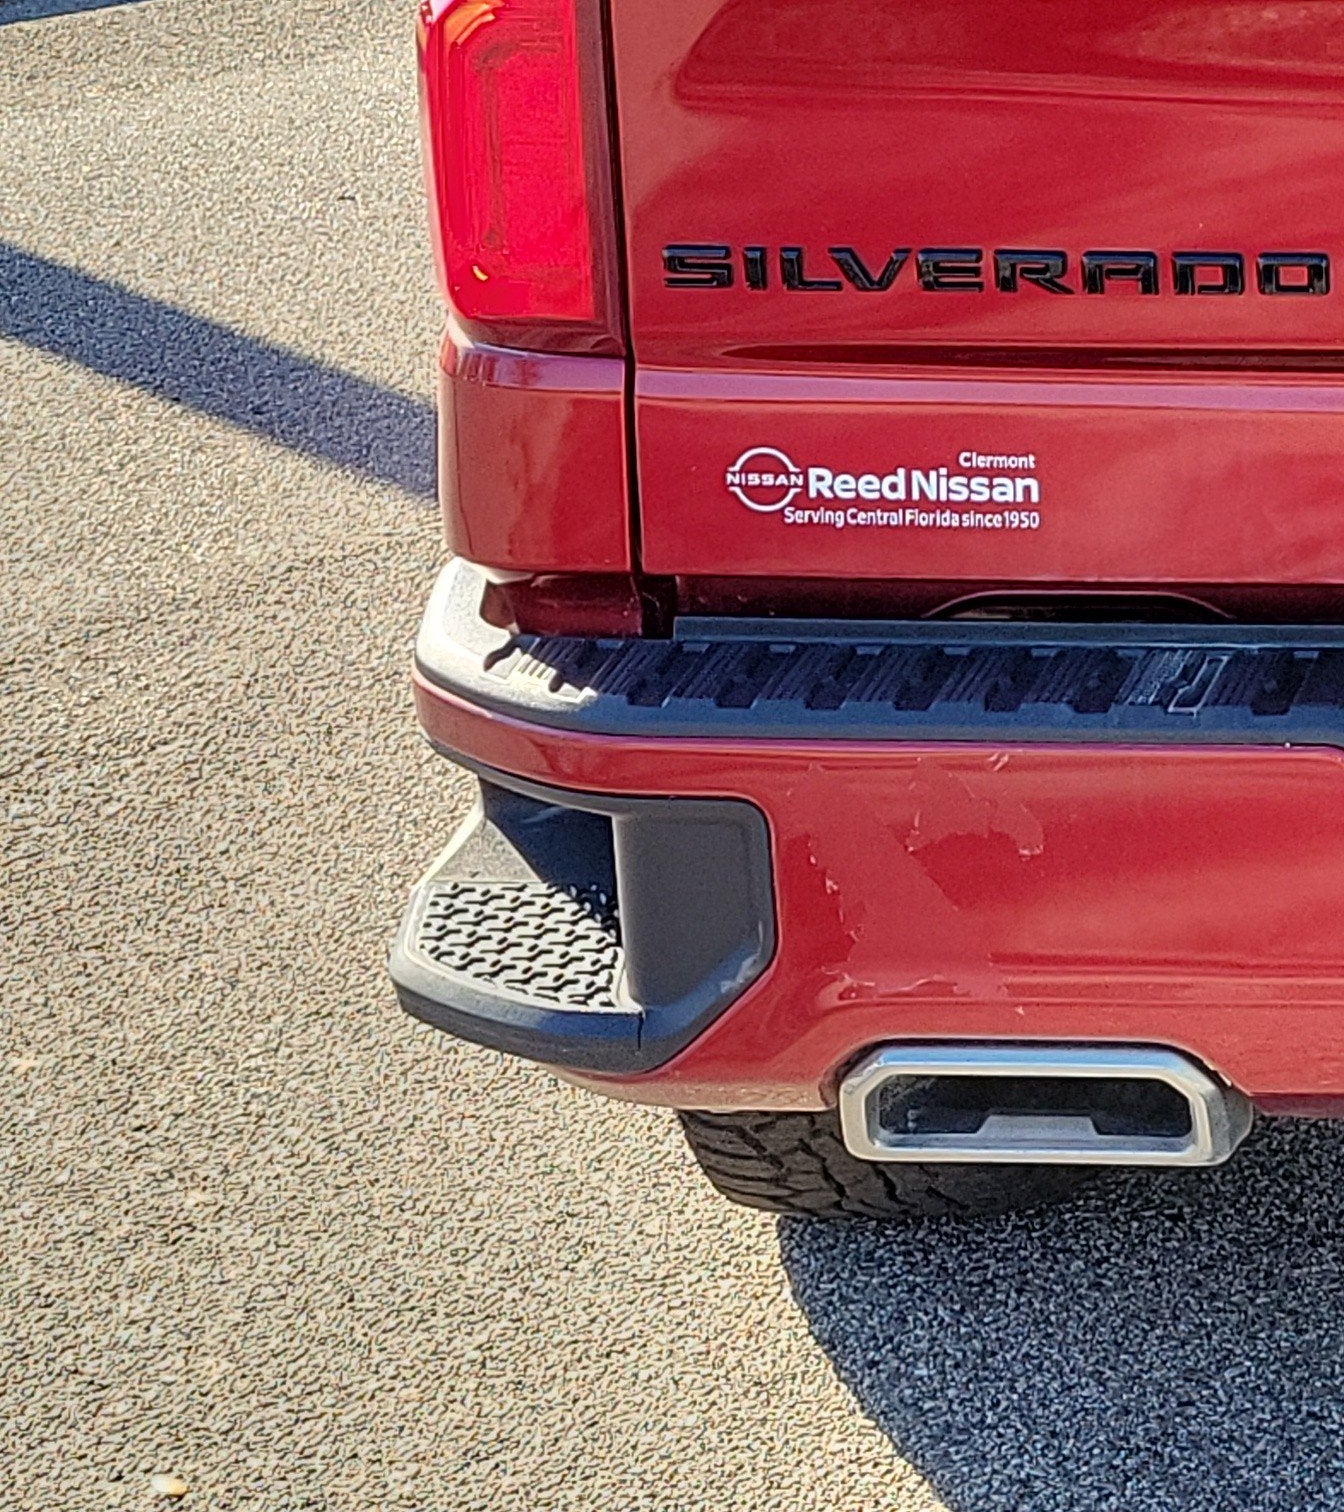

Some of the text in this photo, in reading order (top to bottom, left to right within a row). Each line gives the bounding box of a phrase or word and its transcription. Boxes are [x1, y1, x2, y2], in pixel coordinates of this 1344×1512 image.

[661, 243, 1332, 296] SILVERADO
[958, 451, 1036, 469] Clermont
[726, 472, 804, 486] NISSAN
[784, 506, 1040, 529] Serving Central Florida since 1950
